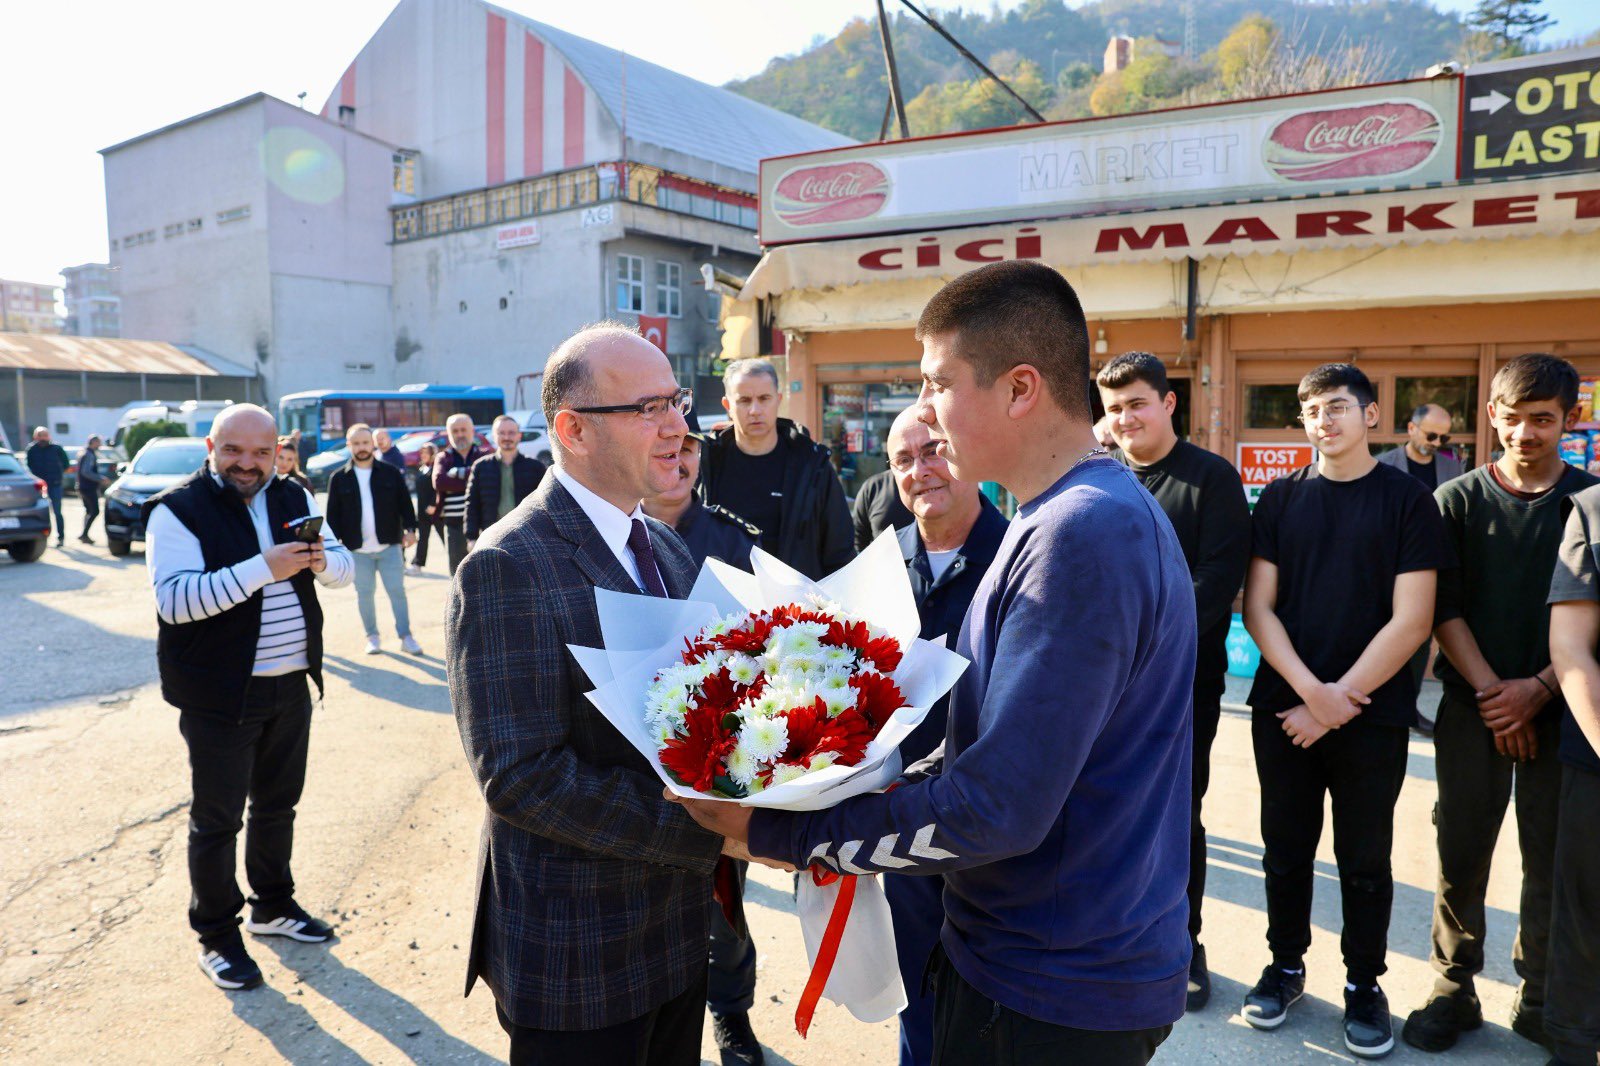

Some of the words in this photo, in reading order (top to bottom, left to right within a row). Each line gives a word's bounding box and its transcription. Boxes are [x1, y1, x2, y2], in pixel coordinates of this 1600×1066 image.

[1304, 114, 1401, 152] Coca-Cola
[1473, 121, 1600, 170] LAST
[1021, 134, 1239, 192] MARKET
[799, 172, 862, 201] Coca-Cola
[1094, 189, 1600, 254] MARKET
[1253, 449, 1298, 465] TOST
